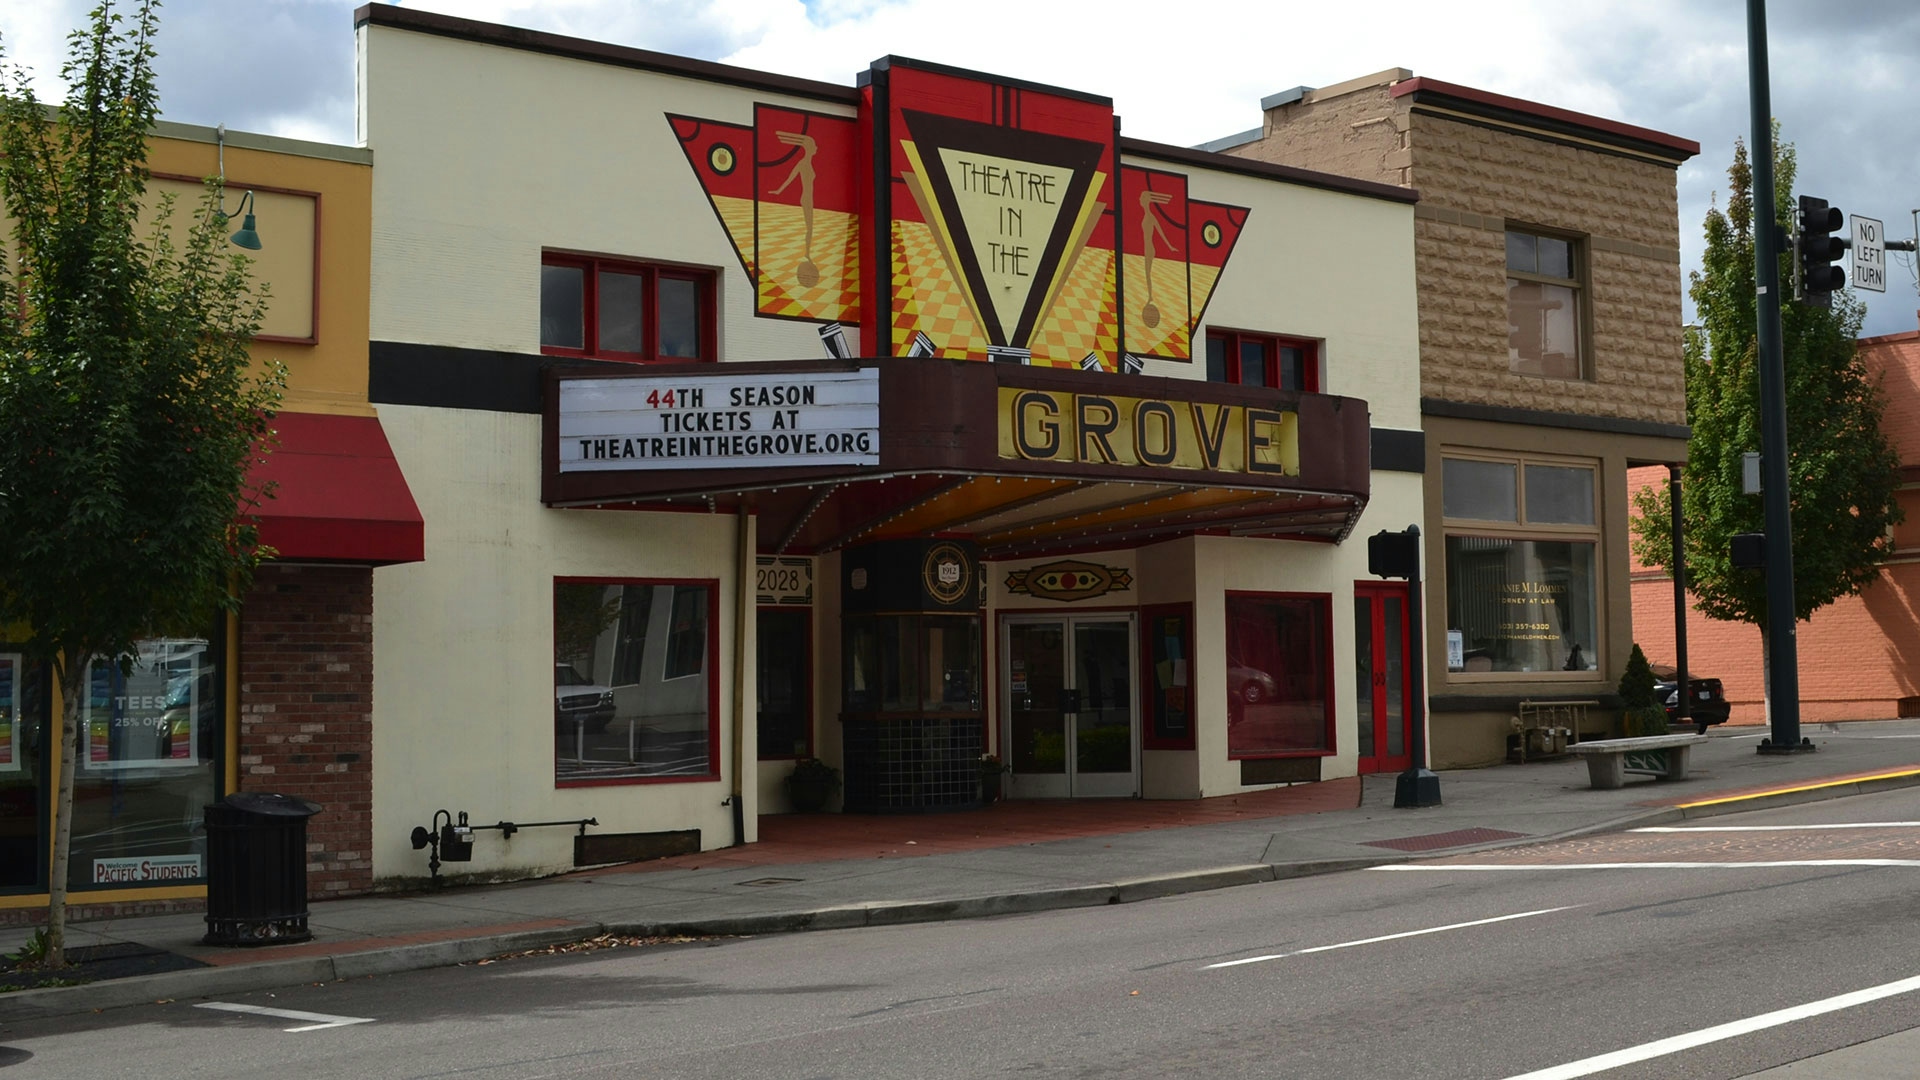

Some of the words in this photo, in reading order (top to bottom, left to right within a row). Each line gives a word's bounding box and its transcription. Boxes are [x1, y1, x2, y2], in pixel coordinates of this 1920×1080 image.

[958, 161, 1055, 204] THEATRE
[1000, 206, 1022, 237] IN
[1860, 223, 1875, 242] NO
[988, 242, 1028, 276] THE
[1858, 245, 1880, 264] LEFT
[1856, 265, 1881, 285] TURN
[646, 388, 703, 408] 44TH
[730, 385, 815, 406] SEASON
[660, 411, 751, 432] TICKETS
[772, 410, 799, 430] AT
[1012, 390, 1283, 475] GROVE
[580, 432, 870, 459] THEATREINTHEGROVE.ORG
[757, 569, 799, 591] 2028
[943, 567, 956, 575] 1912
[114, 695, 165, 710] TEES
[115, 718, 139, 727] 25%
[143, 717, 167, 727] OF
[141, 861, 198, 880] STUDENTS
